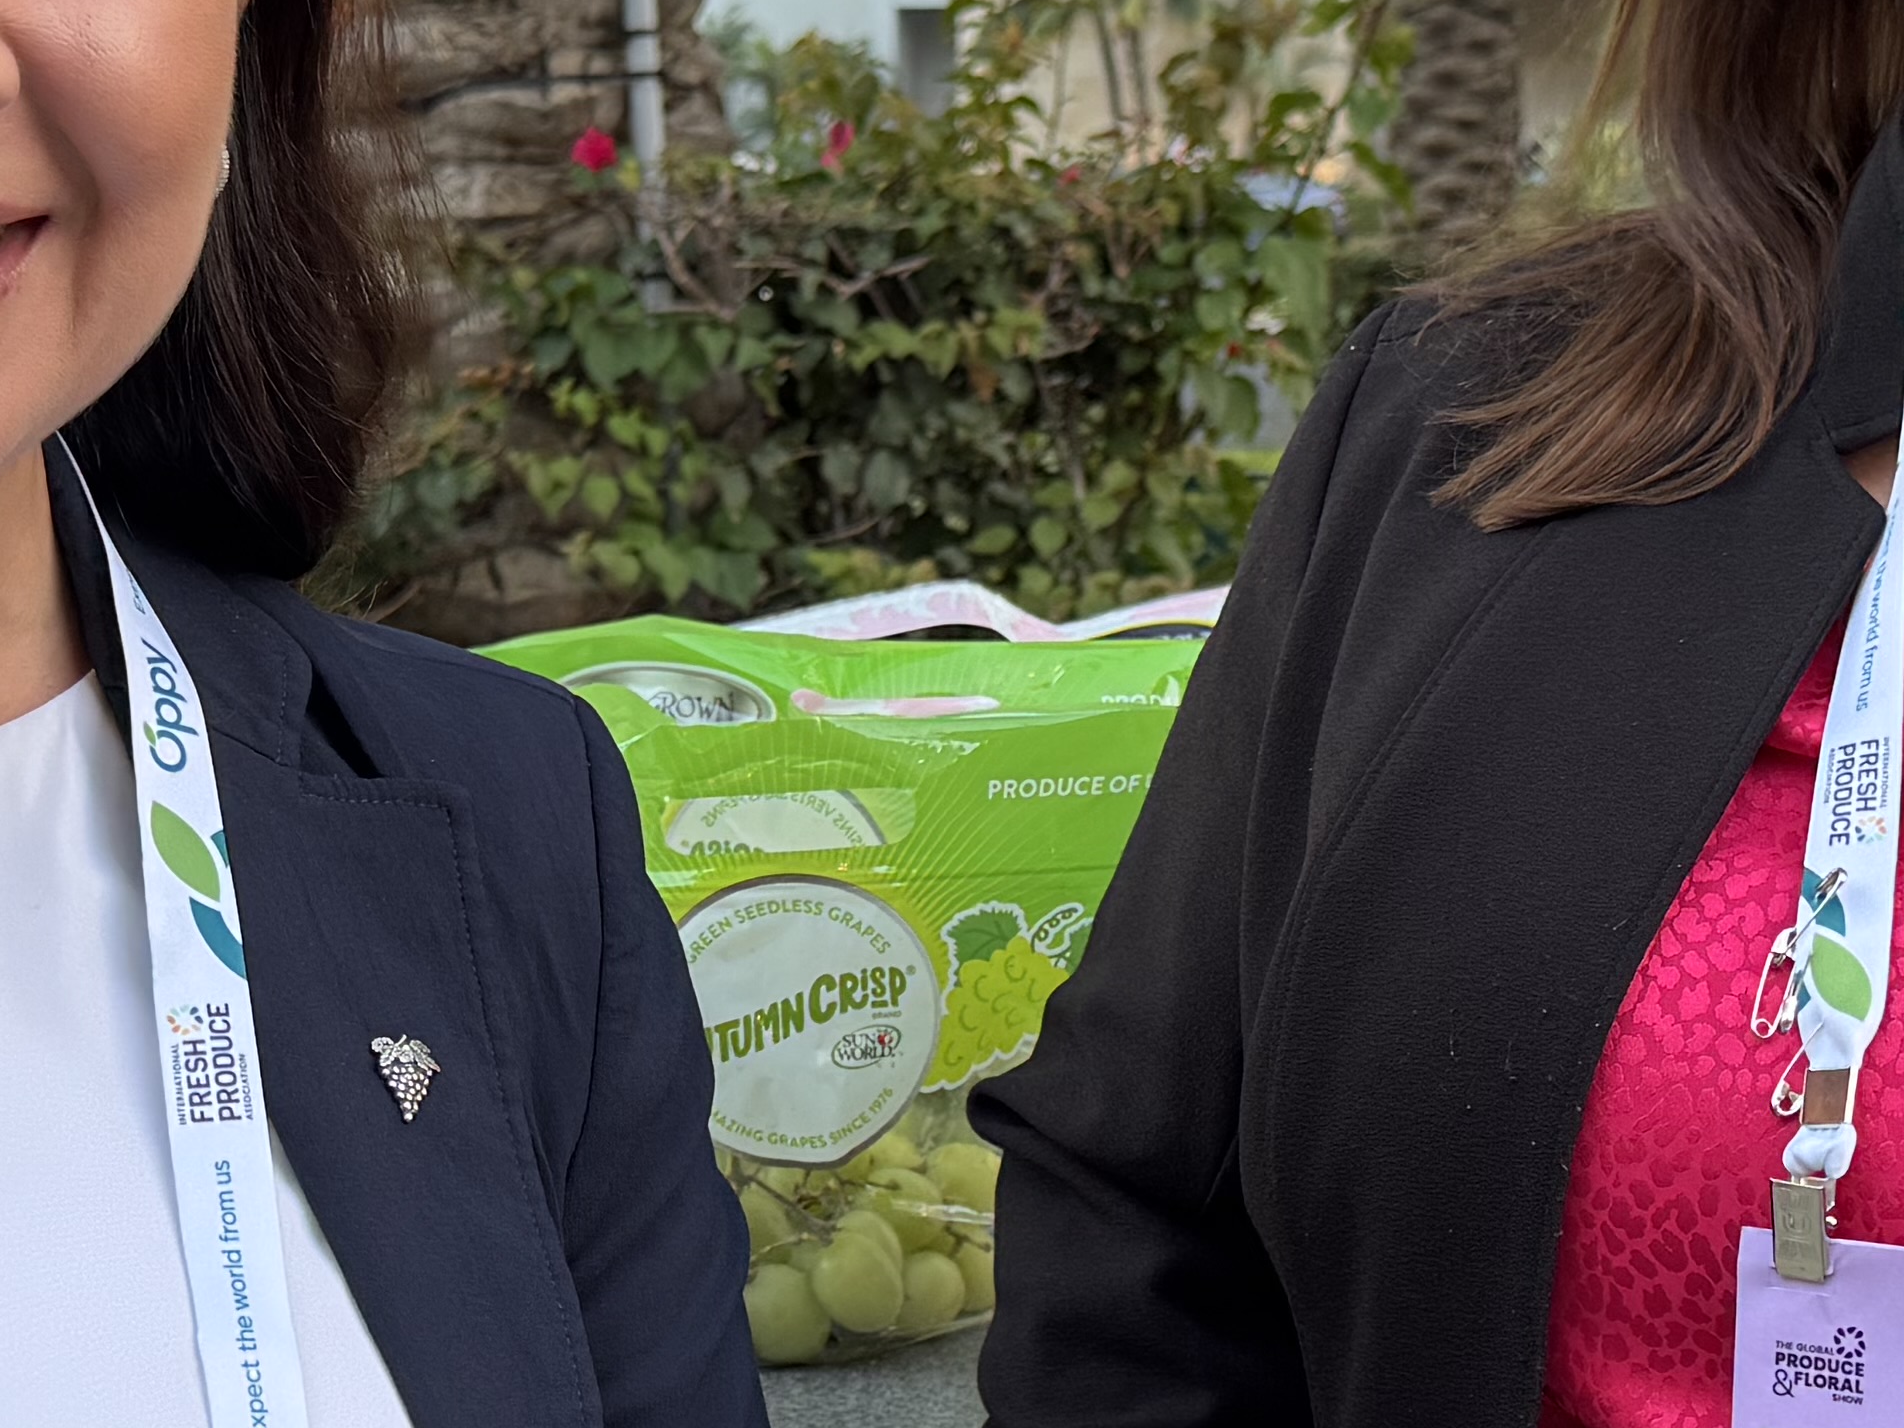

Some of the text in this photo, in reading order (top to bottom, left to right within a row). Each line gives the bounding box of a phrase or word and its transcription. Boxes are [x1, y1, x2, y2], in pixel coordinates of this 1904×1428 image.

[1866, 591, 1883, 644] world
[1859, 644, 1879, 690] from
[142, 636, 200, 773] Oppy
[1855, 690, 1869, 713] us
[988, 776, 1106, 800] PRODUCE
[1109, 774, 1143, 793] OF
[1828, 742, 1857, 848] PRODUCE
[1855, 738, 1880, 813] FRESH
[734, 899, 825, 924] SEEDLESS
[828, 907, 892, 955] GRAPES
[207, 1001, 243, 1123] PRODUCE
[842, 1032, 876, 1048] SUN
[169, 1042, 188, 1126] INTERNATIONAL
[182, 1038, 214, 1125] FRESH
[237, 1053, 254, 1121] ASSOCIATION
[713, 1087, 894, 1149] AZING GRAPES SINCE 1976
[214, 1160, 232, 1184] us
[218, 1189, 242, 1242] from
[222, 1249, 251, 1312] world
[238, 1314, 258, 1353] the
[1775, 1340, 1835, 1356] THE GLOBAL
[1772, 1369, 1864, 1398] & FLORAL
[1775, 1351, 1866, 1378] PRODUCE
[1832, 1393, 1864, 1406] SHOW
